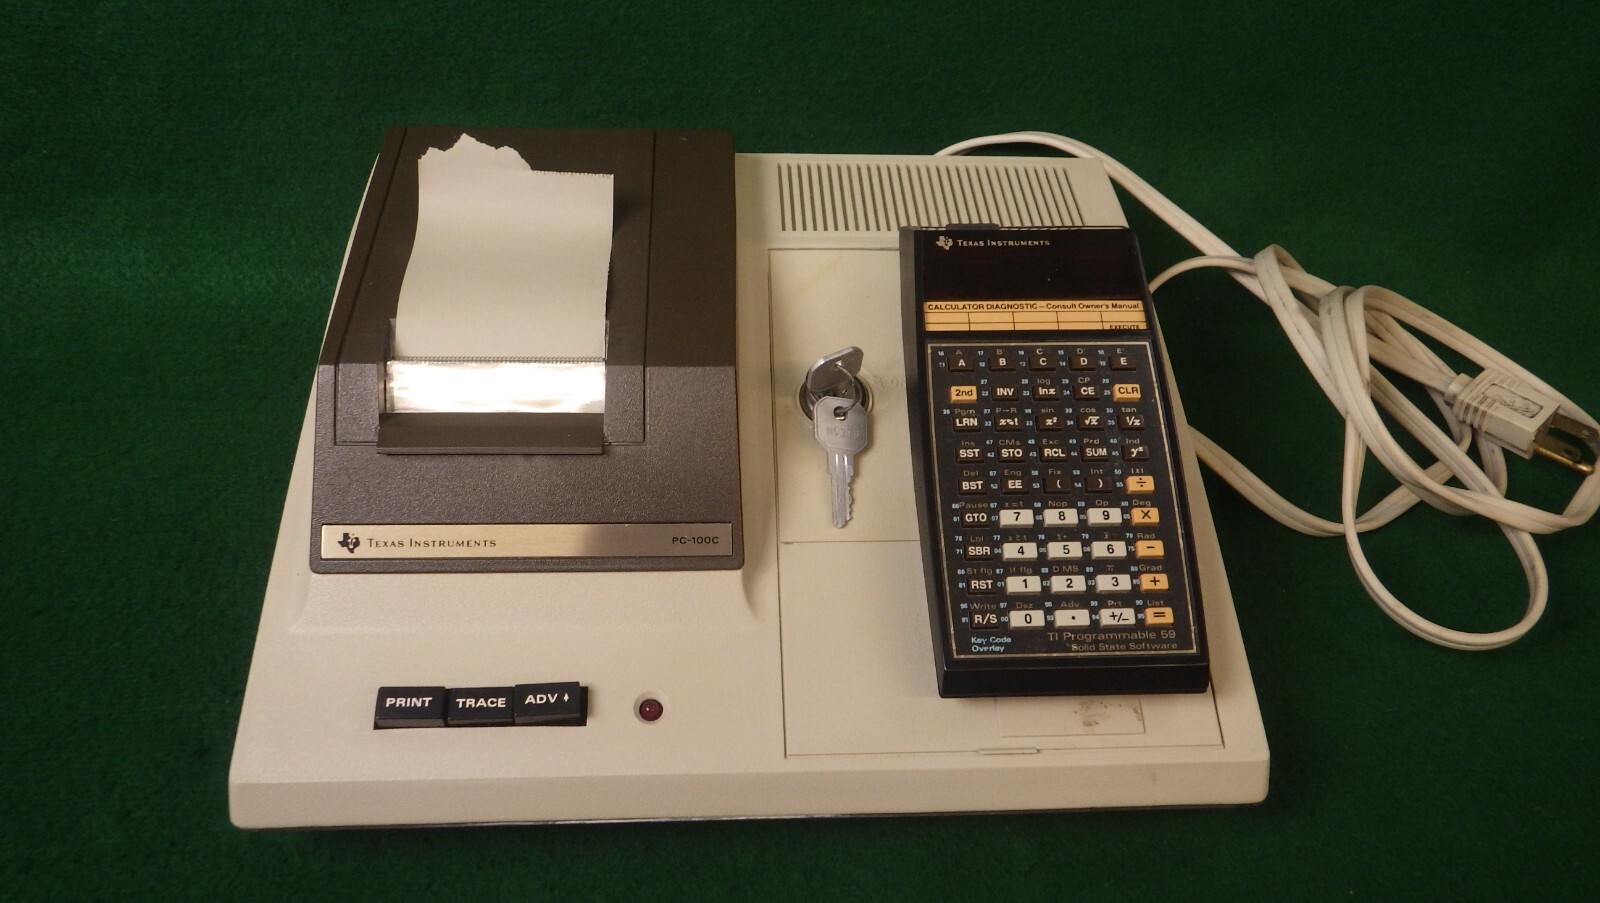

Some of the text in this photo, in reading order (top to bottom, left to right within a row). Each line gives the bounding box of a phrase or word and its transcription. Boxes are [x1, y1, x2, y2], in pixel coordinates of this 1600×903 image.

[996, 388, 1014, 396] INV
[956, 418, 977, 426] LRN
[960, 449, 980, 458] SST
[1001, 449, 1022, 457] STO
[1086, 448, 1107, 456] SUM
[962, 481, 983, 490] BST
[1008, 480, 1022, 488] EE
[965, 513, 987, 522] GTO
[1013, 512, 1021, 521] 7
[1058, 511, 1066, 521] 8
[1102, 510, 1110, 520] 9
[968, 547, 991, 556] SBR
[1017, 546, 1025, 556] 4
[1063, 544, 1070, 554] 5
[1107, 544, 1114, 554] 6
[971, 580, 994, 590] RST
[1022, 578, 1028, 588] 1
[1066, 578, 1073, 589] 2
[1111, 576, 1119, 587] 3
[974, 613, 997, 625] R/S
[1024, 613, 1032, 624] 0
[971, 637, 987, 645] Key
[1063, 632, 1156, 642] Programmable
[1160, 630, 1176, 639] 59
[1129, 642, 1178, 650] Software
[386, 697, 432, 708] PRINT
[456, 698, 506, 708] TRACE
[525, 693, 558, 704] ADV
